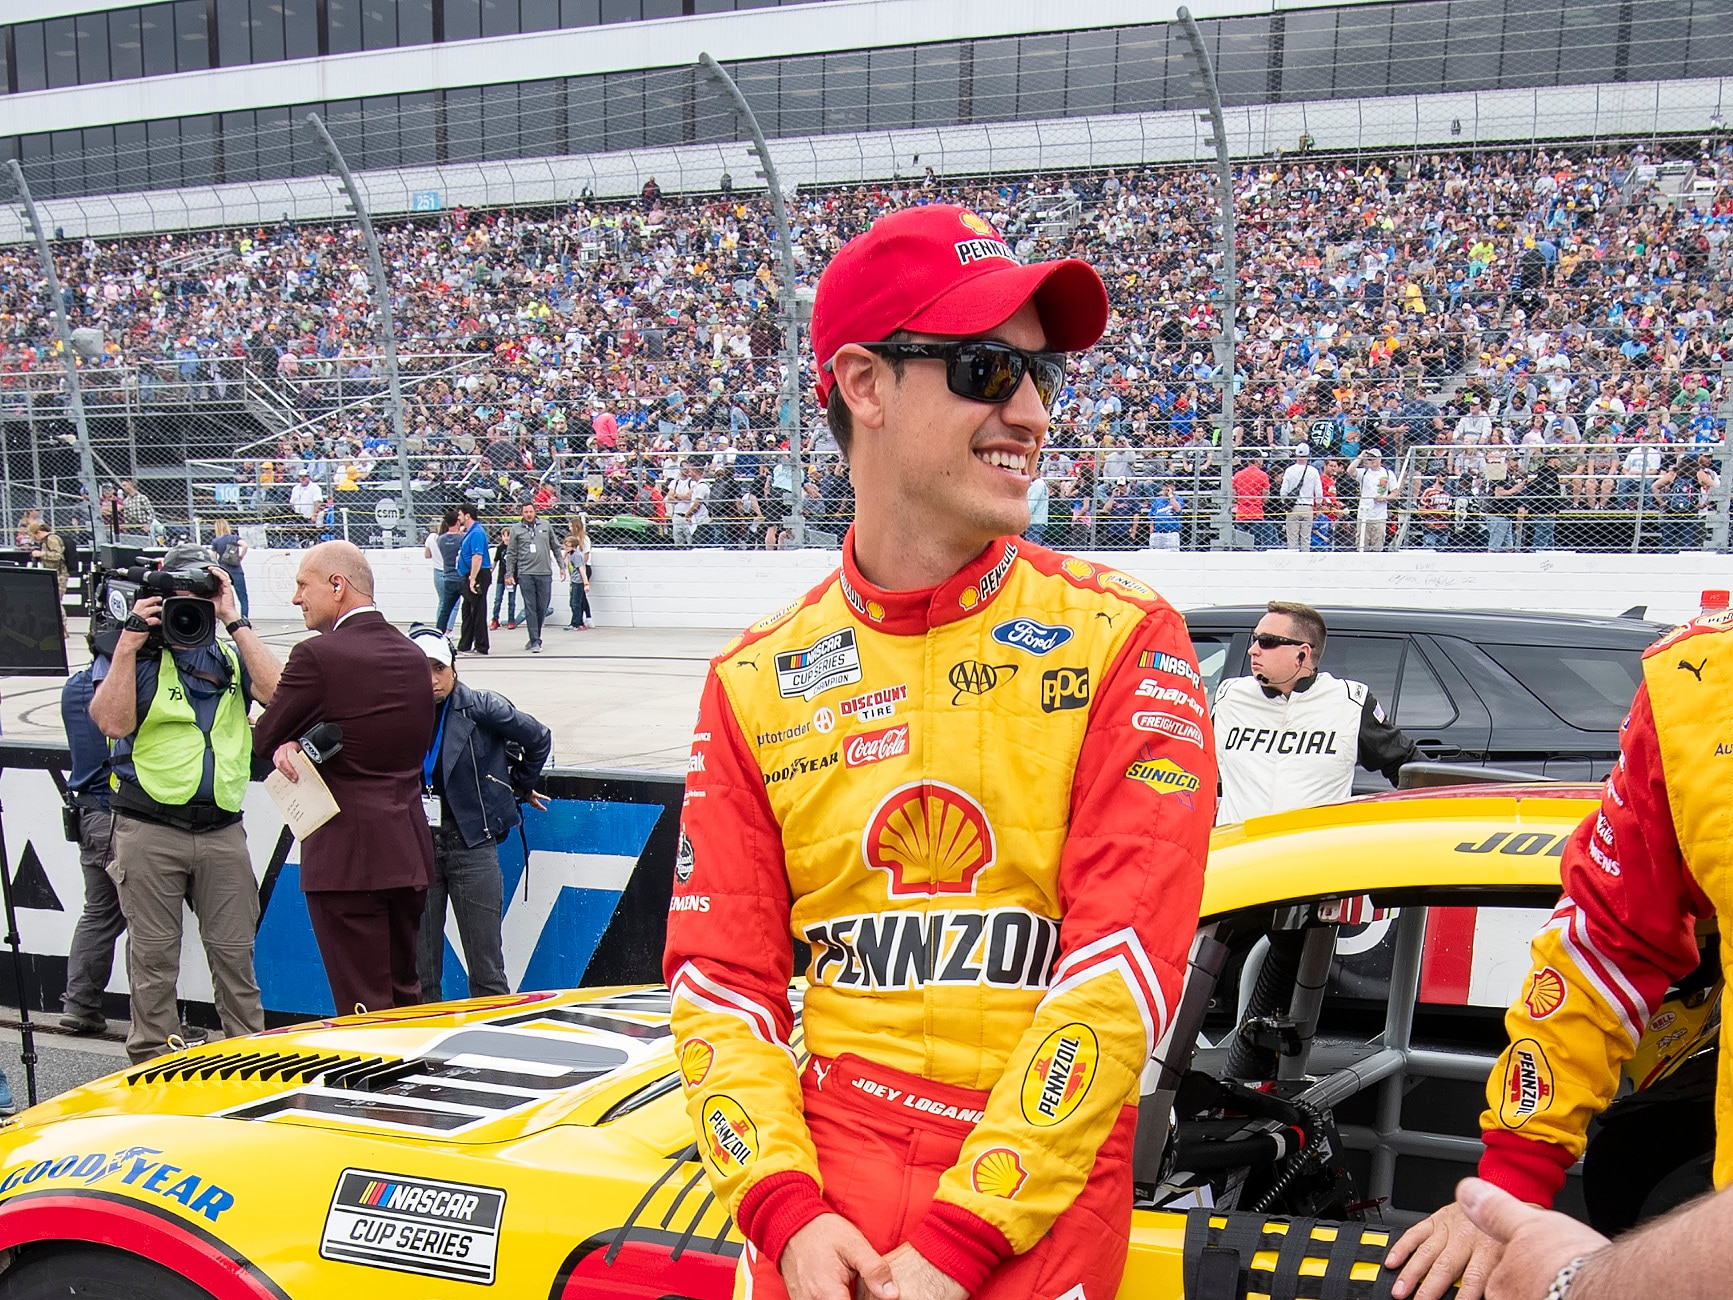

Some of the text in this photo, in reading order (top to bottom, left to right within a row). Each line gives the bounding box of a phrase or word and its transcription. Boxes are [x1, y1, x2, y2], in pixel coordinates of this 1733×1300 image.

[377, 509, 398, 518] csm
[1008, 620, 1059, 651] Ford
[792, 653, 846, 687] CUP SERIES
[812, 673, 849, 695] CHAMPION
[955, 661, 994, 693] AAA
[840, 685, 907, 716] DISCOUNT
[862, 705, 892, 720] TIRE
[1134, 678, 1205, 718] Snap-on
[1225, 726, 1337, 755] OFFICIAL
[1127, 763, 1198, 790] SUNOCO
[851, 1077, 903, 1101] JOEY
[1038, 1037, 1080, 1117] PENNZOIL
[1515, 1050, 1538, 1115] PENNZOIL
[709, 1109, 752, 1166] PENNZOIL
[386, 1184, 480, 1221] NASCAR
[349, 1218, 473, 1258] CUP SERIES
